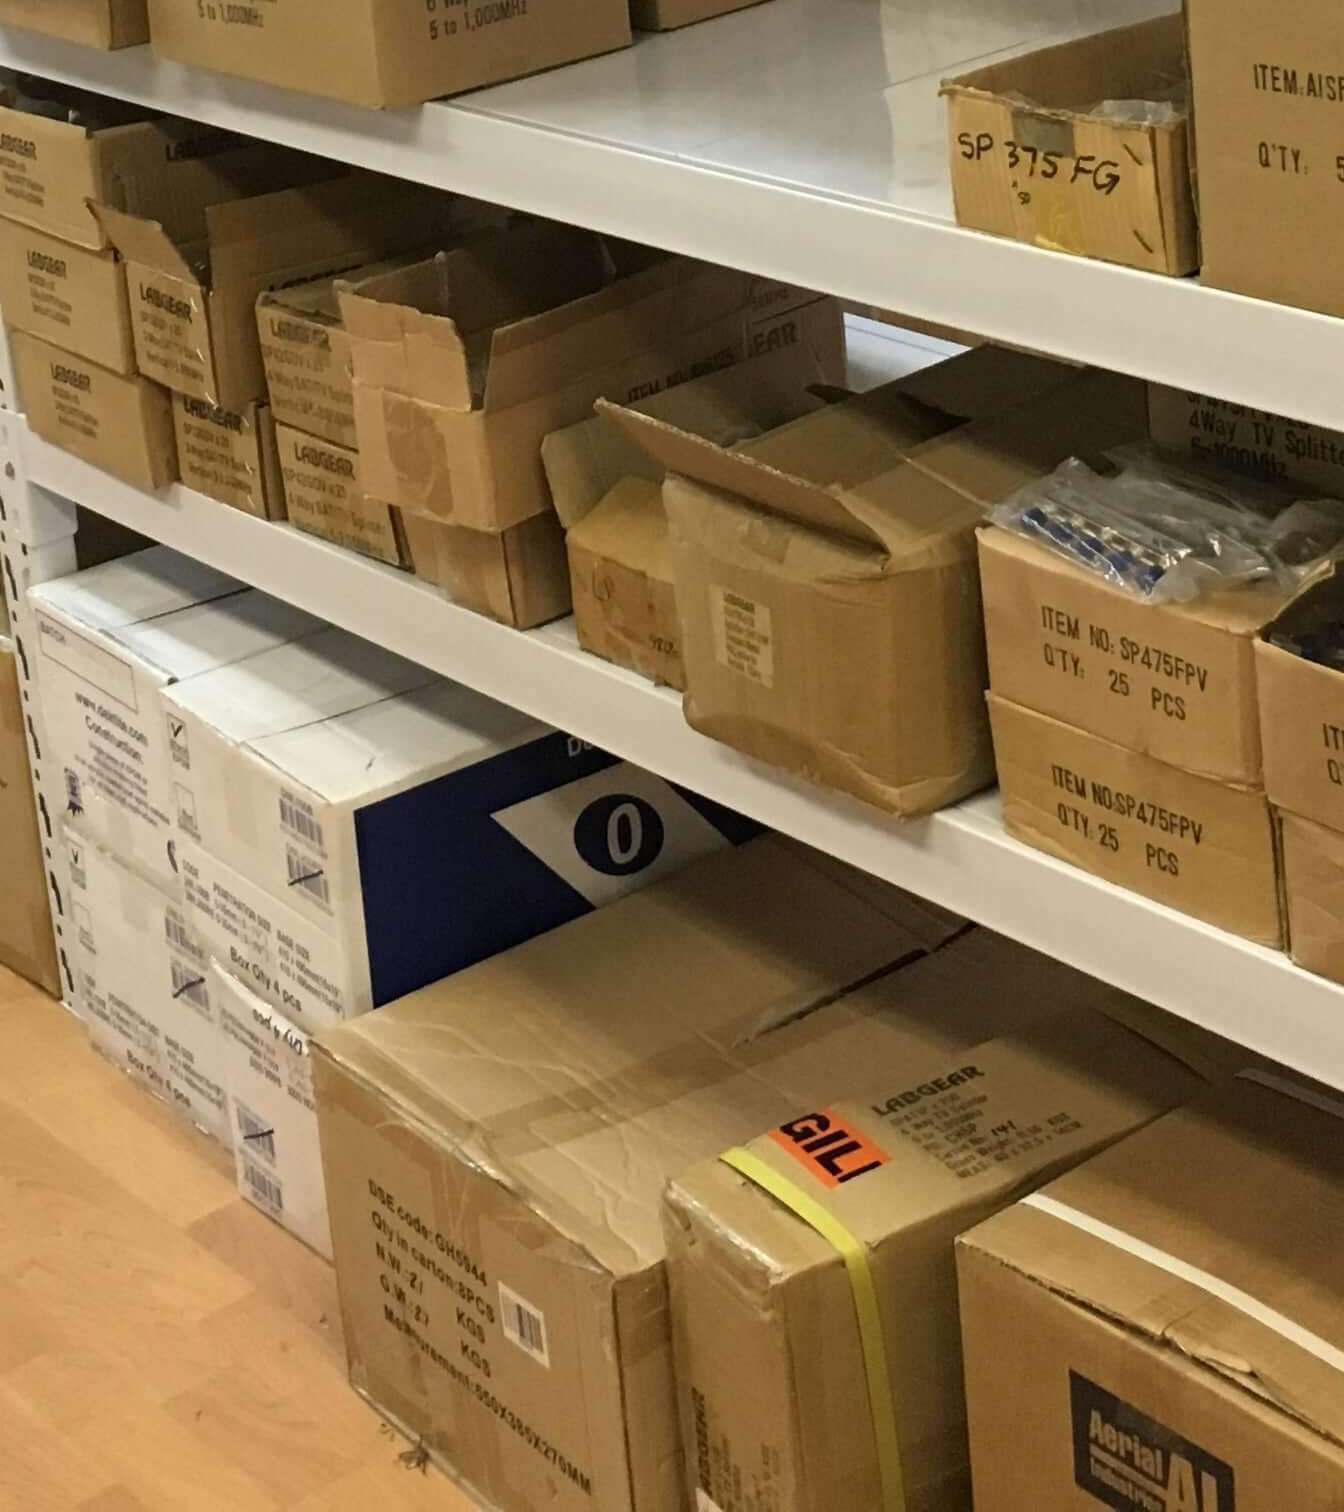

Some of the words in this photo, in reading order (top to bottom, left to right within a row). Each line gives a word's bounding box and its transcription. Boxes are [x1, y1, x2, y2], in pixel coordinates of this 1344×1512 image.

[430, 20, 438, 40] 5
[444, 19, 457, 36] to
[956, 131, 994, 162] SP
[1004, 139, 1059, 179] 375
[1069, 155, 1122, 196] FG
[140, 282, 193, 324] LABGEAR
[1251, 422, 1275, 446] TV
[295, 441, 357, 480] LABGEAR
[1041, 605, 1080, 640] ITEM
[1108, 669, 1130, 697] 25
[1151, 687, 1186, 721] PCS
[1051, 764, 1087, 800] ITEM
[1098, 824, 1119, 852] 25
[1146, 843, 1179, 876] PCS
[872, 1064, 985, 1117] LABGEAR
[456, 1306, 486, 1345] KGS
[460, 1339, 492, 1379] KGS
[1089, 1408, 1165, 1482] Aerial
